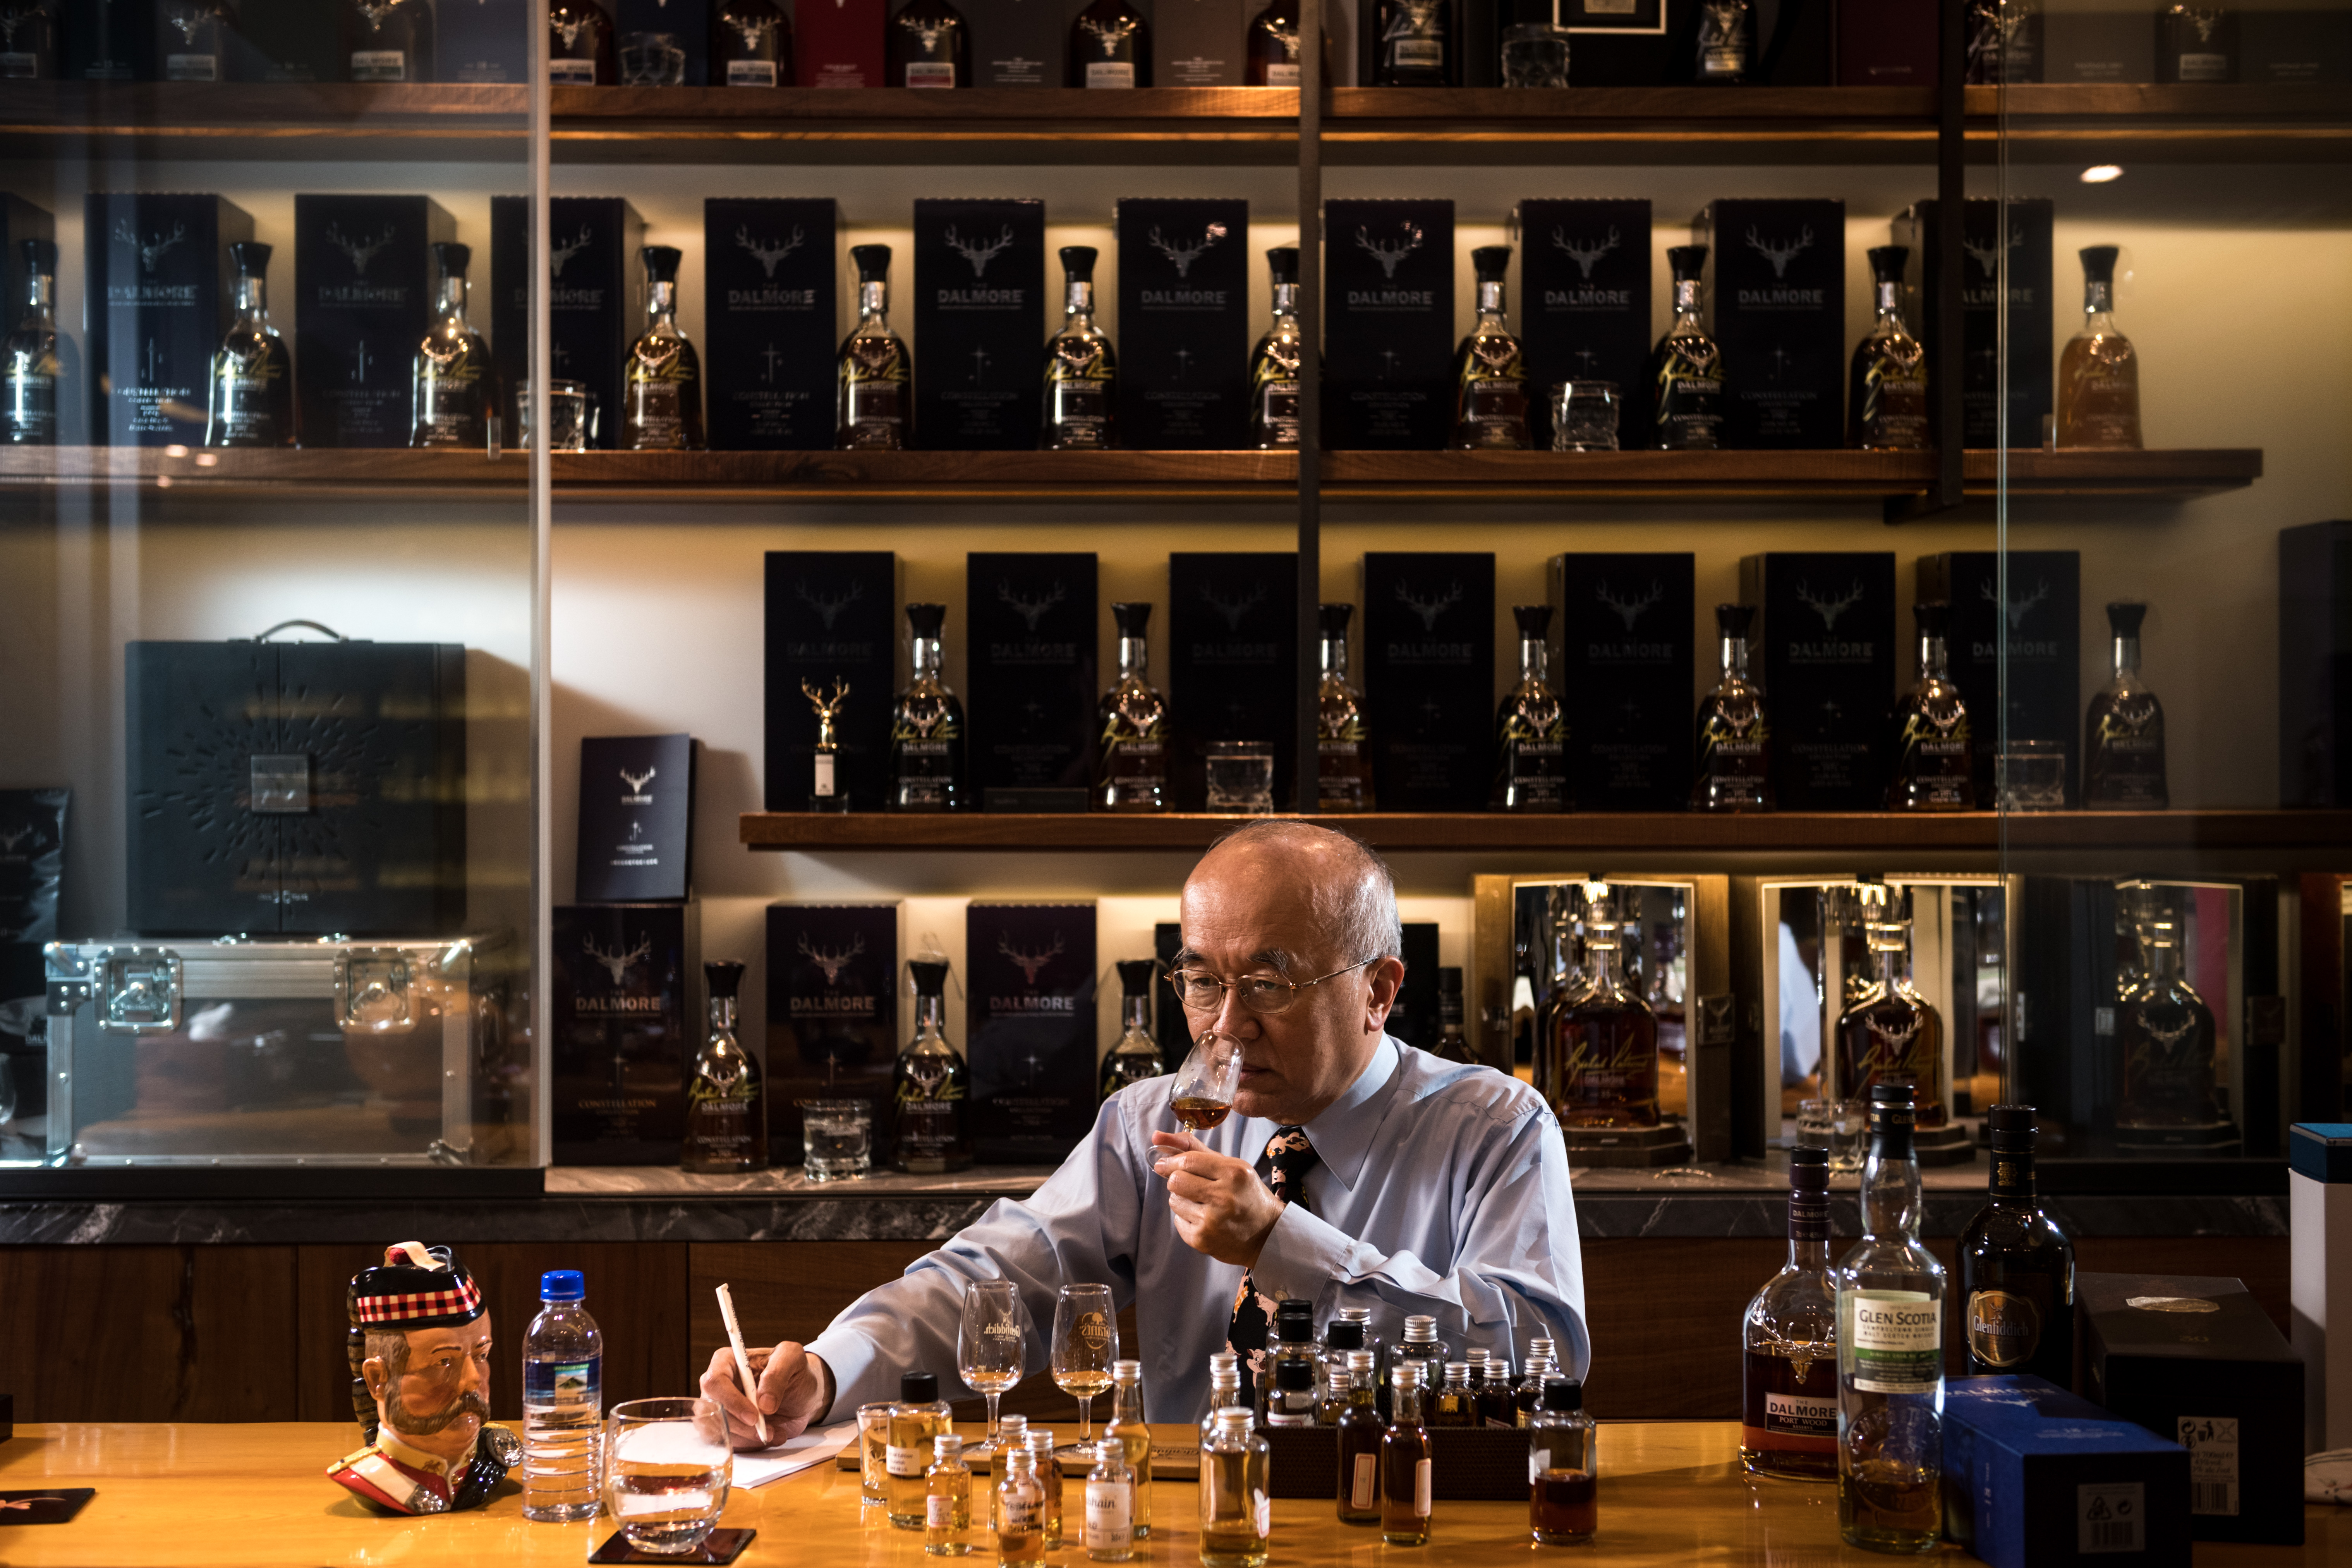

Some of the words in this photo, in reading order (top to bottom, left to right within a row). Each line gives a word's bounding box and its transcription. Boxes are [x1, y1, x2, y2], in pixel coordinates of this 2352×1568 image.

[515, 289, 602, 304] DMORE
[728, 290, 815, 304] DALMORE
[937, 290, 1023, 304] DALMORE
[1141, 290, 1227, 304] DALMORE
[1348, 291, 1434, 304] DALMORE
[1545, 290, 1630, 304] DALMORE
[1738, 290, 1823, 304] DALMORE
[990, 643, 1076, 657] DALMORE
[1192, 643, 1277, 657] DALMORE
[1387, 643, 1473, 657] DALMORE
[1588, 643, 1674, 657] DALMORE
[1789, 642, 1875, 656] DALMORE
[1972, 642, 2057, 656] DAMORE
[1591, 744, 1668, 754] CONSTELLATION
[1792, 744, 1869, 754] CONSTELLATION
[575, 997, 661, 1011] DALMORE
[790, 997, 875, 1010] DALMORE
[990, 997, 1074, 1010] DALMORE
[579, 1099, 656, 1108] CONSTELLATION
[701, 1103, 748, 1111] DALMORE
[906, 1102, 952, 1111] DALMORE
[1793, 1209, 1828, 1218] DALMORE
[1859, 1309, 1893, 1324] GLEN
[1896, 1312, 1936, 1325] SCOTIA
[1973, 1315, 2029, 1336] Glenfiddich
[1770, 1402, 1837, 1417] DALMORE
[1779, 1416, 1799, 1424] PORT
